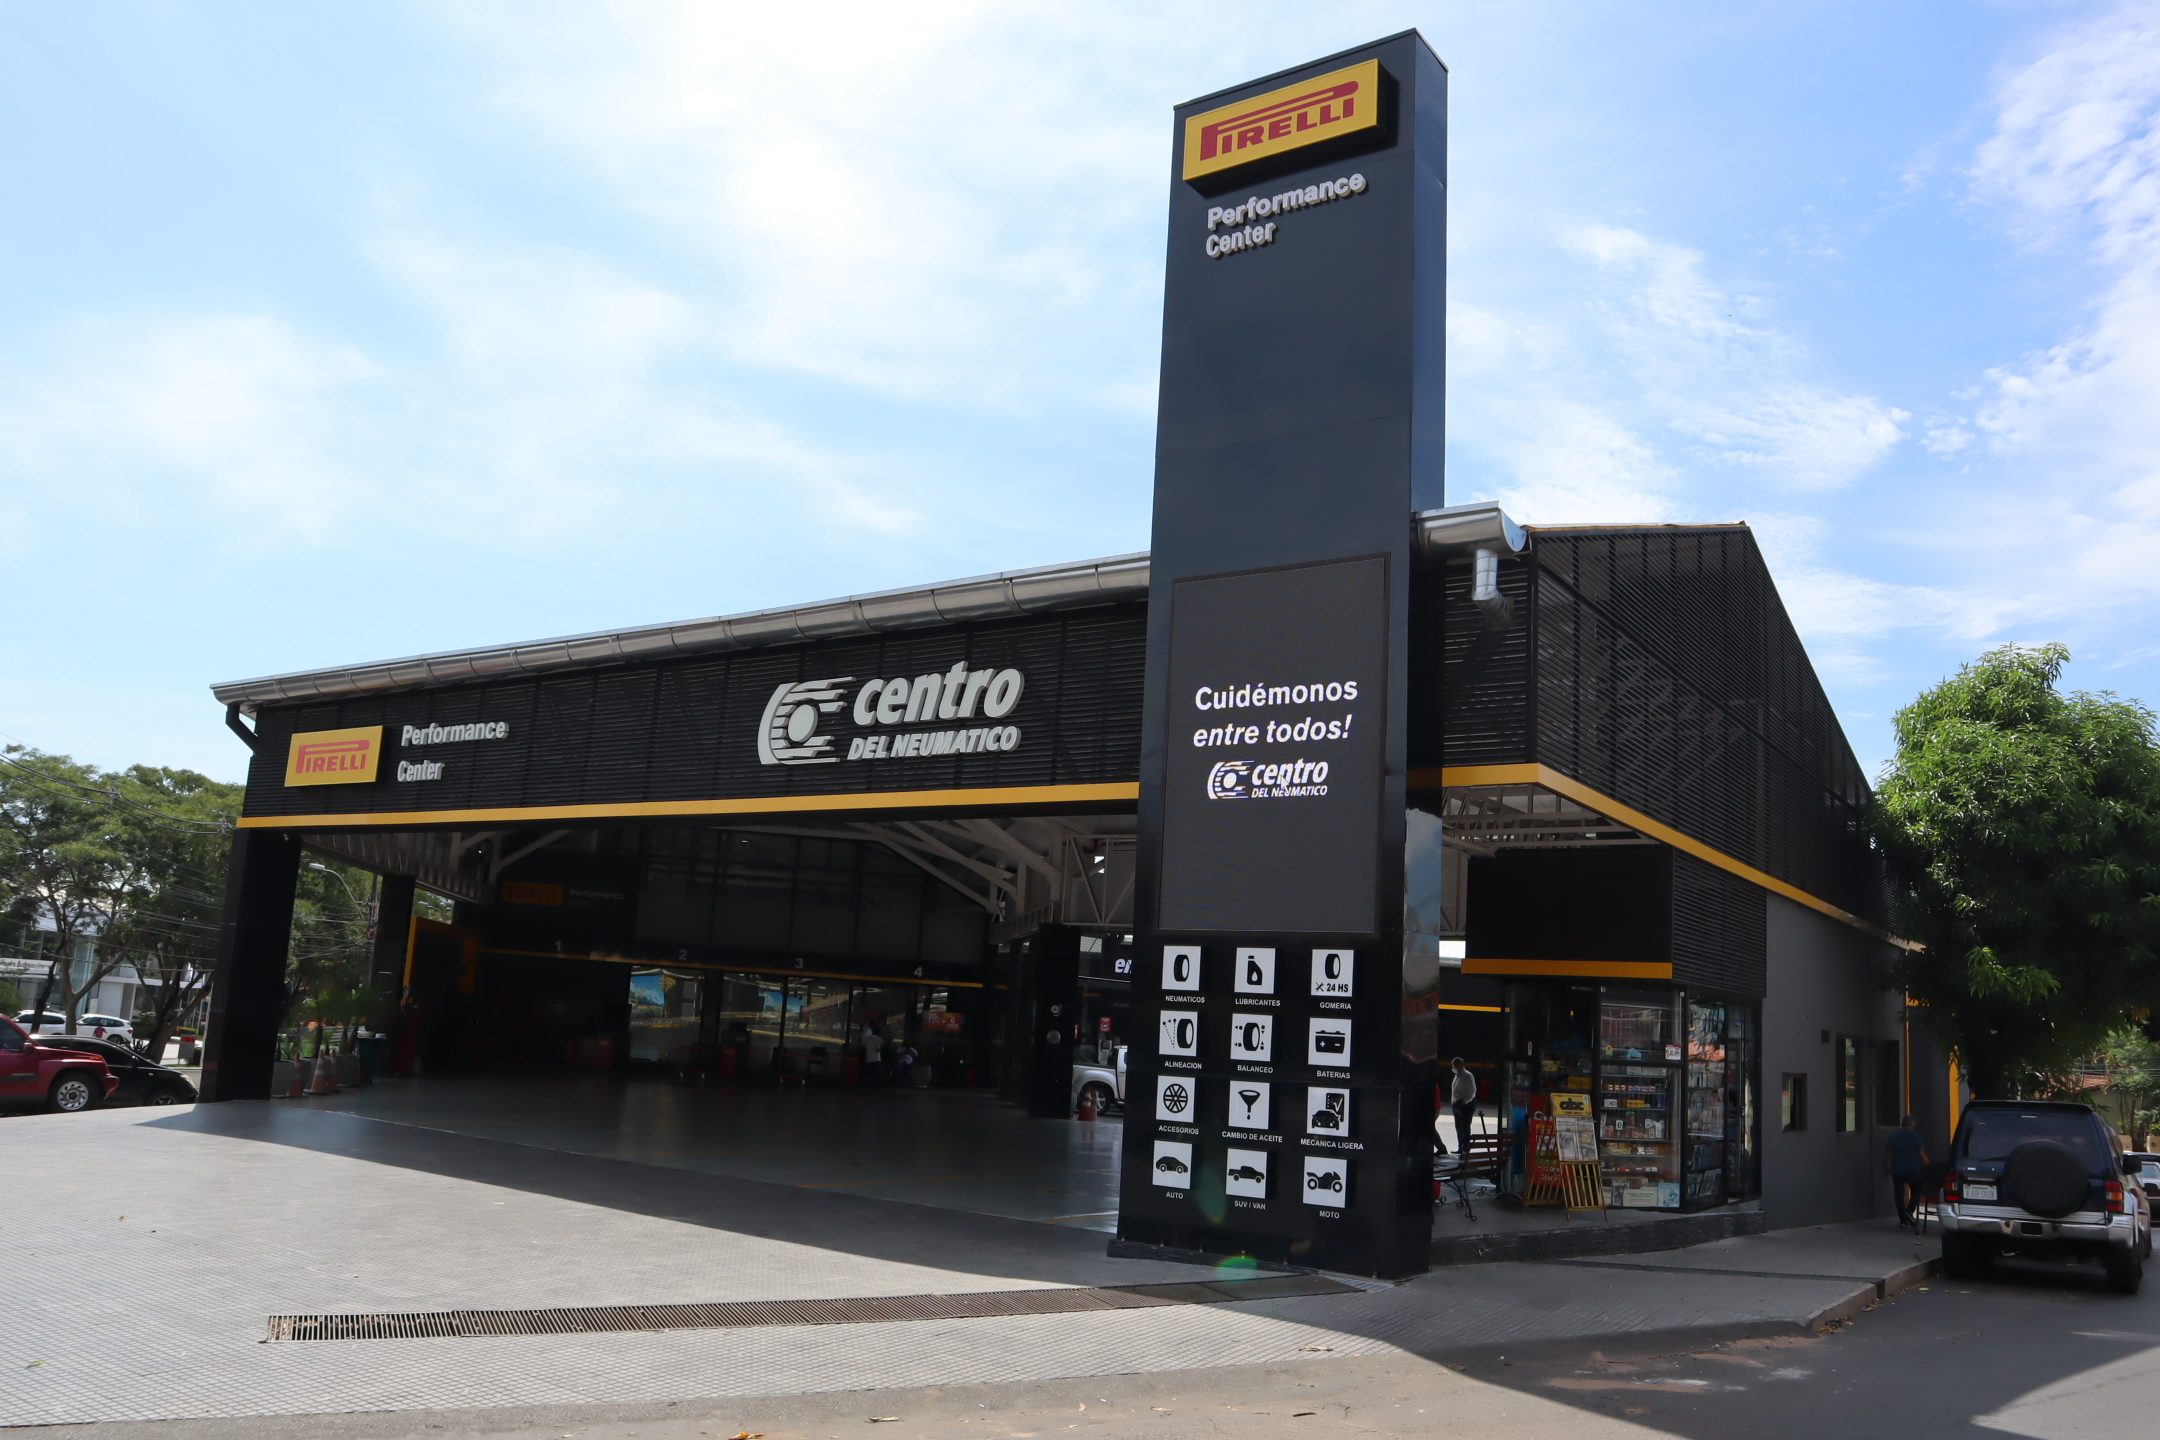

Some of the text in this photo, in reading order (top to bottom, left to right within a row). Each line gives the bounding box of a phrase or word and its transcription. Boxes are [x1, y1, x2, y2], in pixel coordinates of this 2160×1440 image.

[1200, 81, 1358, 161] PIRELLI
[1207, 173, 1366, 230] Performance
[1205, 221, 1276, 258] Center
[853, 660, 1024, 726] centro
[1195, 681, 1358, 711] Cuidémonos
[401, 721, 509, 747] Performance
[1193, 714, 1353, 747] entre todos!
[847, 725, 1022, 760] DEL NEUMATICO
[295, 740, 370, 774] PIRELLI
[397, 759, 445, 782] Center
[1251, 758, 1329, 786] centro
[1251, 784, 1328, 798] DEL NEUMATICO
[553, 940, 564, 952] 1
[677, 949, 688, 961] 2
[795, 957, 805, 969] 3
[913, 966, 923, 978] 4
[1327, 983, 1349, 992] 24 HS
[1165, 995, 1206, 1004] NEUMATICOS
[1235, 998, 1281, 1007] LUBRICANTES
[1319, 1001, 1352, 1010] GOMERIA
[1164, 1060, 1203, 1070] ALINEACION
[1237, 1064, 1274, 1074] BALANCEO
[1316, 1070, 1351, 1079] BATERIAS
[1158, 1125, 1200, 1135] ACCESORIOS
[1221, 1130, 1283, 1143] CAMBIO DE ACEITE
[1300, 1138, 1364, 1150] MECANICA LIGERA
[1165, 1191, 1184, 1200] AUTO
[1234, 1200, 1248, 1208] SUV
[1252, 1202, 1266, 1210] VAN
[1319, 1210, 1340, 1219] MOTO
